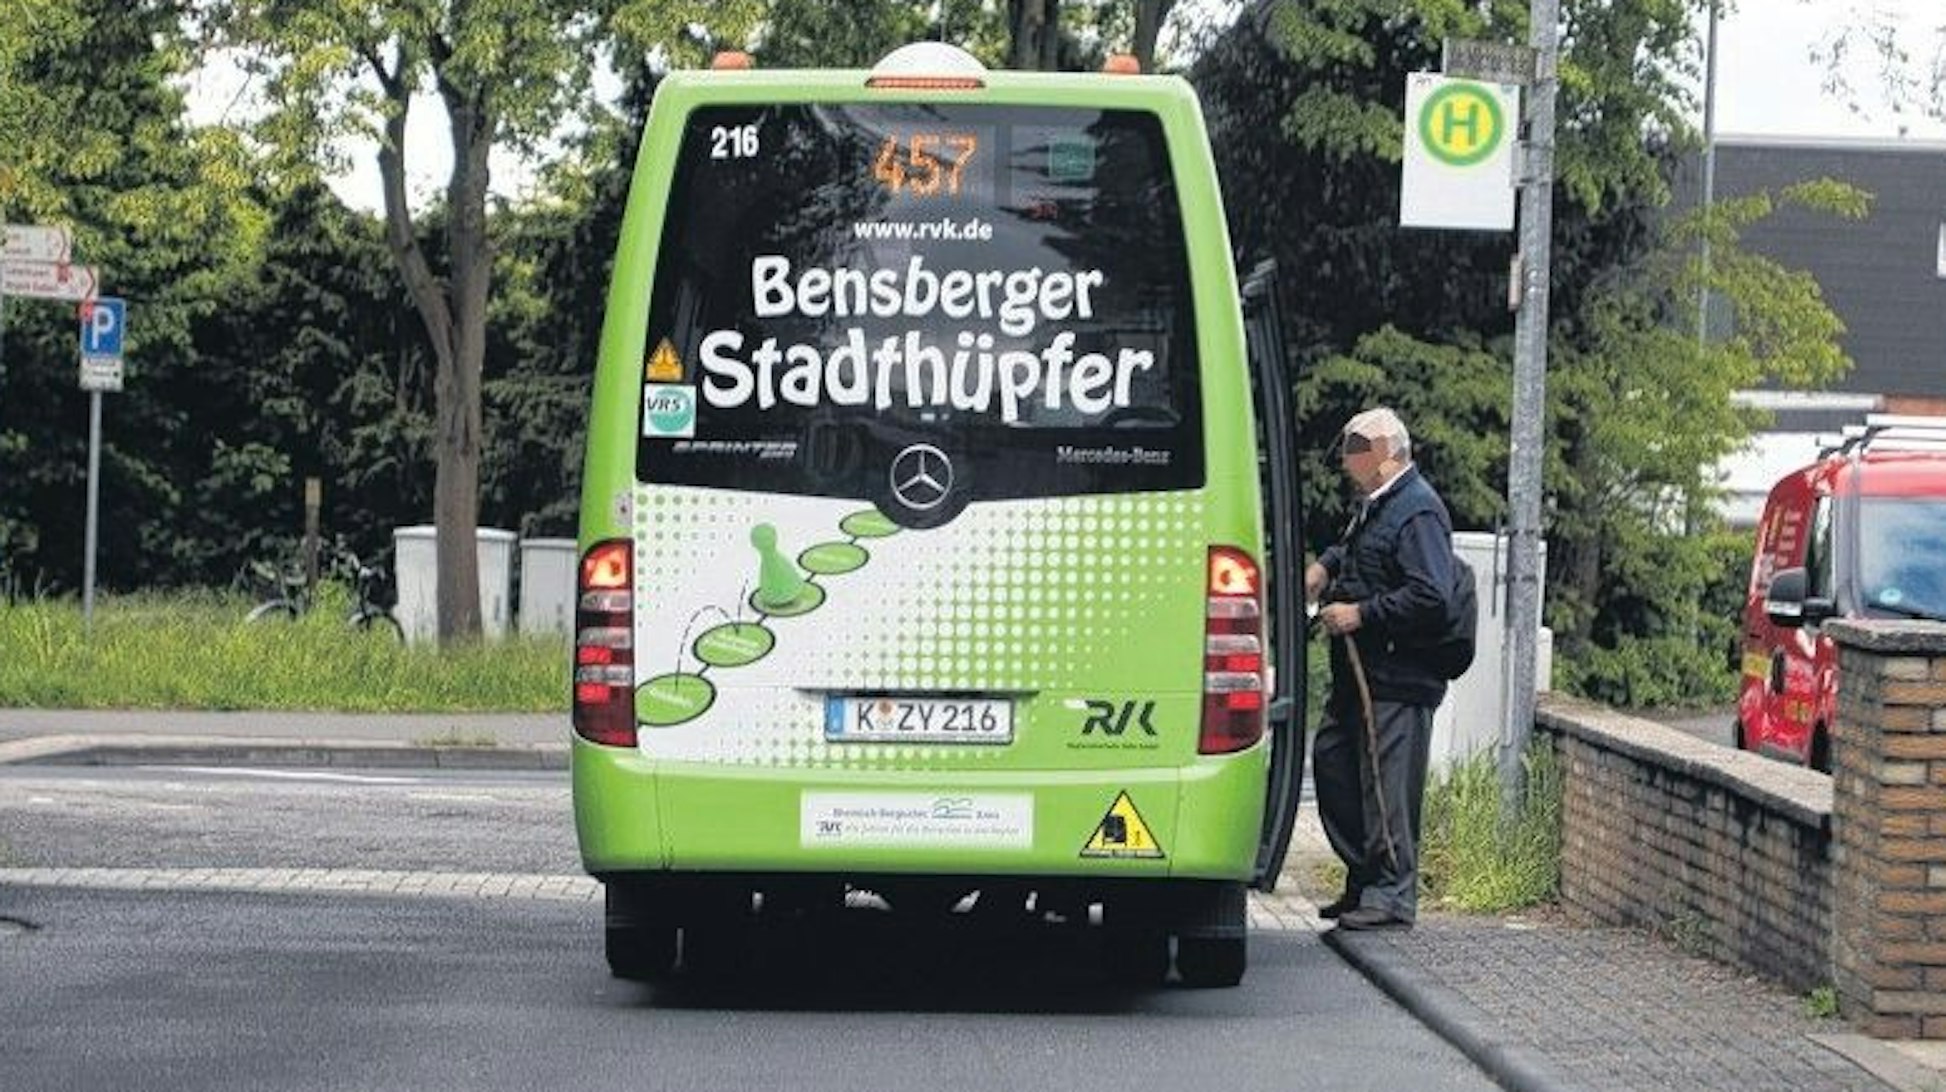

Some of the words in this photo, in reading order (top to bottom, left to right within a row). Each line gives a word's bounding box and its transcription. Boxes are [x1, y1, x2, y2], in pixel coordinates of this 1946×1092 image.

[710, 125, 760, 159] 216
[1443, 102, 1480, 147] H
[872, 130, 978, 198] 457
[854, 217, 994, 241] www.rvk.de
[751, 254, 1104, 337] Bensberger
[91, 305, 115, 350] P
[699, 327, 1155, 424] Stadthüpfer
[647, 397, 681, 412] VRS
[1056, 444, 1172, 464] Mercedes-Benz
[857, 703, 875, 731] K
[897, 703, 934, 731] ZY
[941, 704, 997, 732] 216
[1081, 699, 1158, 736] RVK
